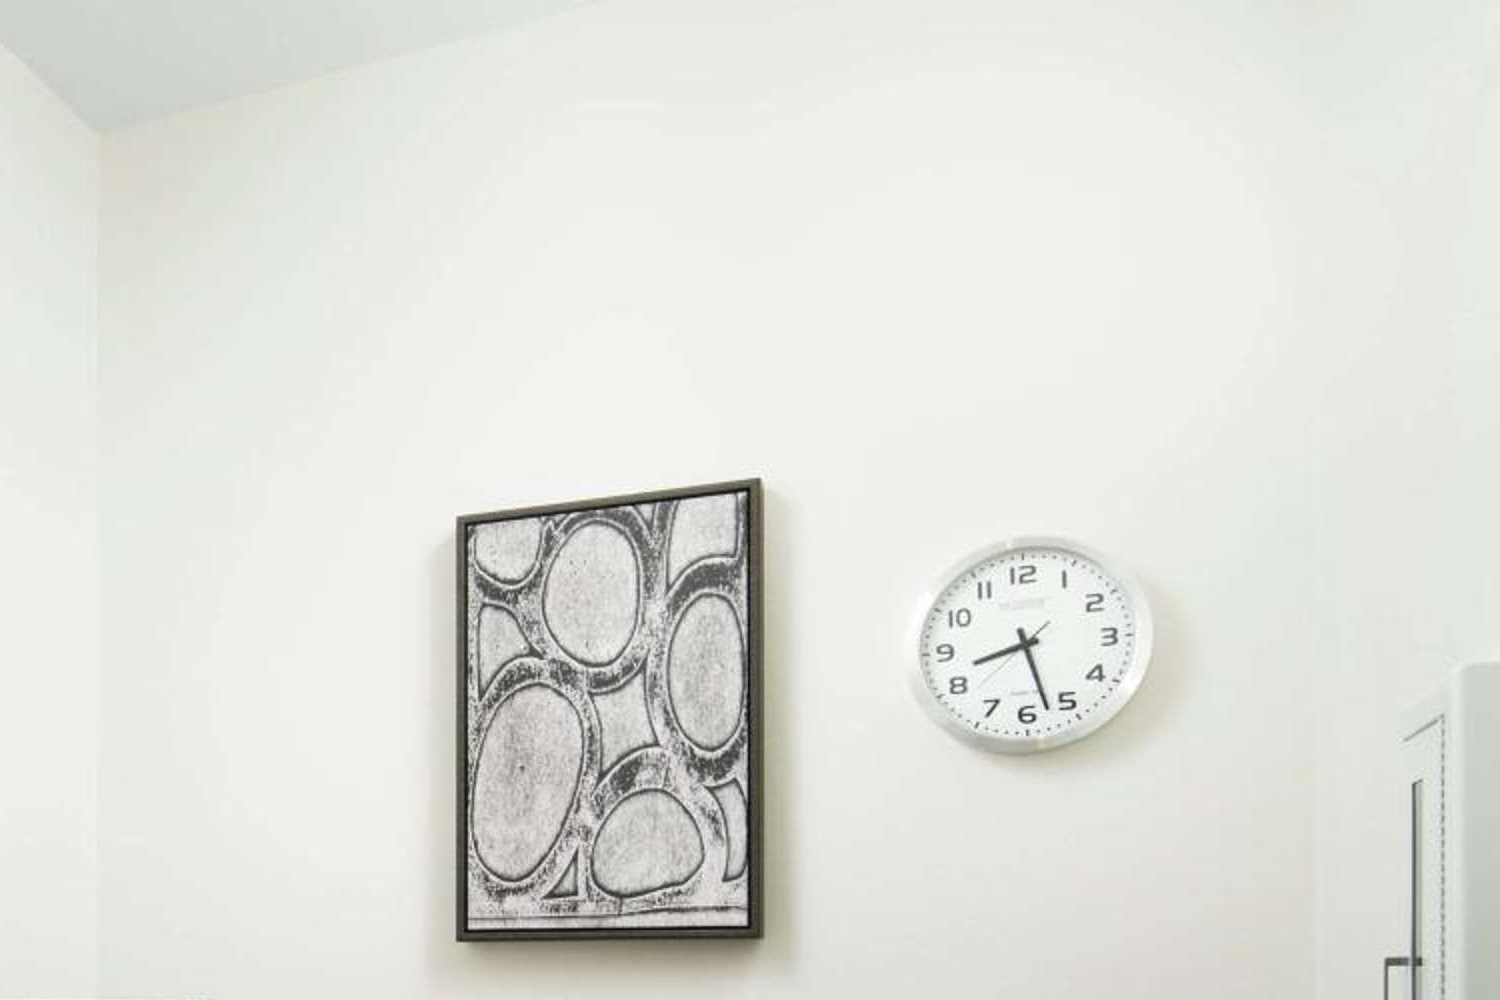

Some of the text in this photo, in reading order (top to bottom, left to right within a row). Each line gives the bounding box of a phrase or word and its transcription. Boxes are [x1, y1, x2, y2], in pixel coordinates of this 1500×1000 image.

[1010, 565, 1037, 585] 12
[1061, 570, 1067, 588] 1
[977, 581, 992, 600] 11
[1085, 593, 1104, 612] 2
[948, 608, 971, 628] 10
[1101, 627, 1118, 646] 3
[936, 643, 955, 662] 9
[1085, 664, 1105, 682] 4
[949, 676, 968, 694] 8
[983, 699, 1001, 718] 7
[1058, 691, 1077, 710] 5
[1017, 705, 1037, 724] 6
